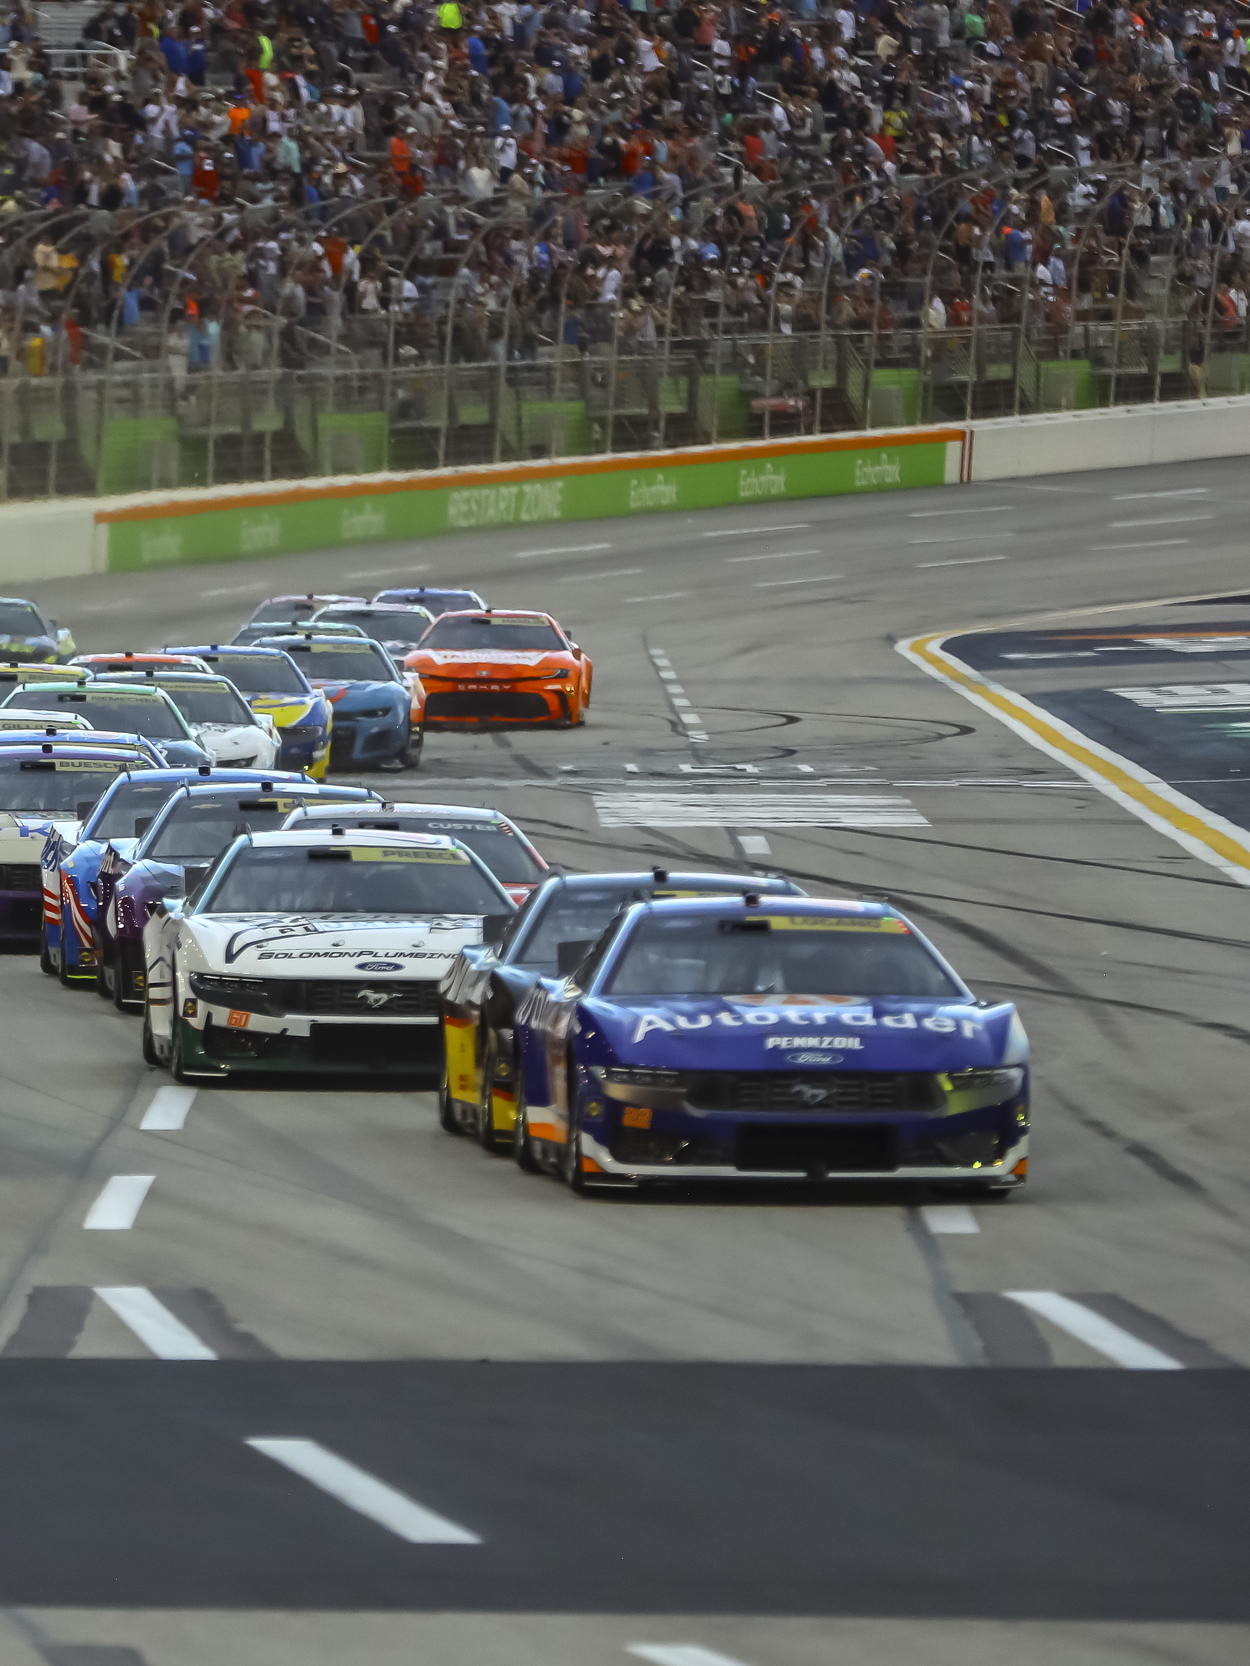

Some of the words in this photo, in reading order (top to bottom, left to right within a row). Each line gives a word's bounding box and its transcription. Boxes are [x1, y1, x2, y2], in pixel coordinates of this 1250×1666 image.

[520, 481, 564, 521] ZONE
[427, 822, 497, 831] CUSTER
[382, 850, 461, 861] PREECE
[228, 1009, 251, 1028] 60
[634, 1009, 984, 1044] Autotrader
[765, 1036, 865, 1051] PENNZOIL
[622, 1107, 653, 1129] 22
